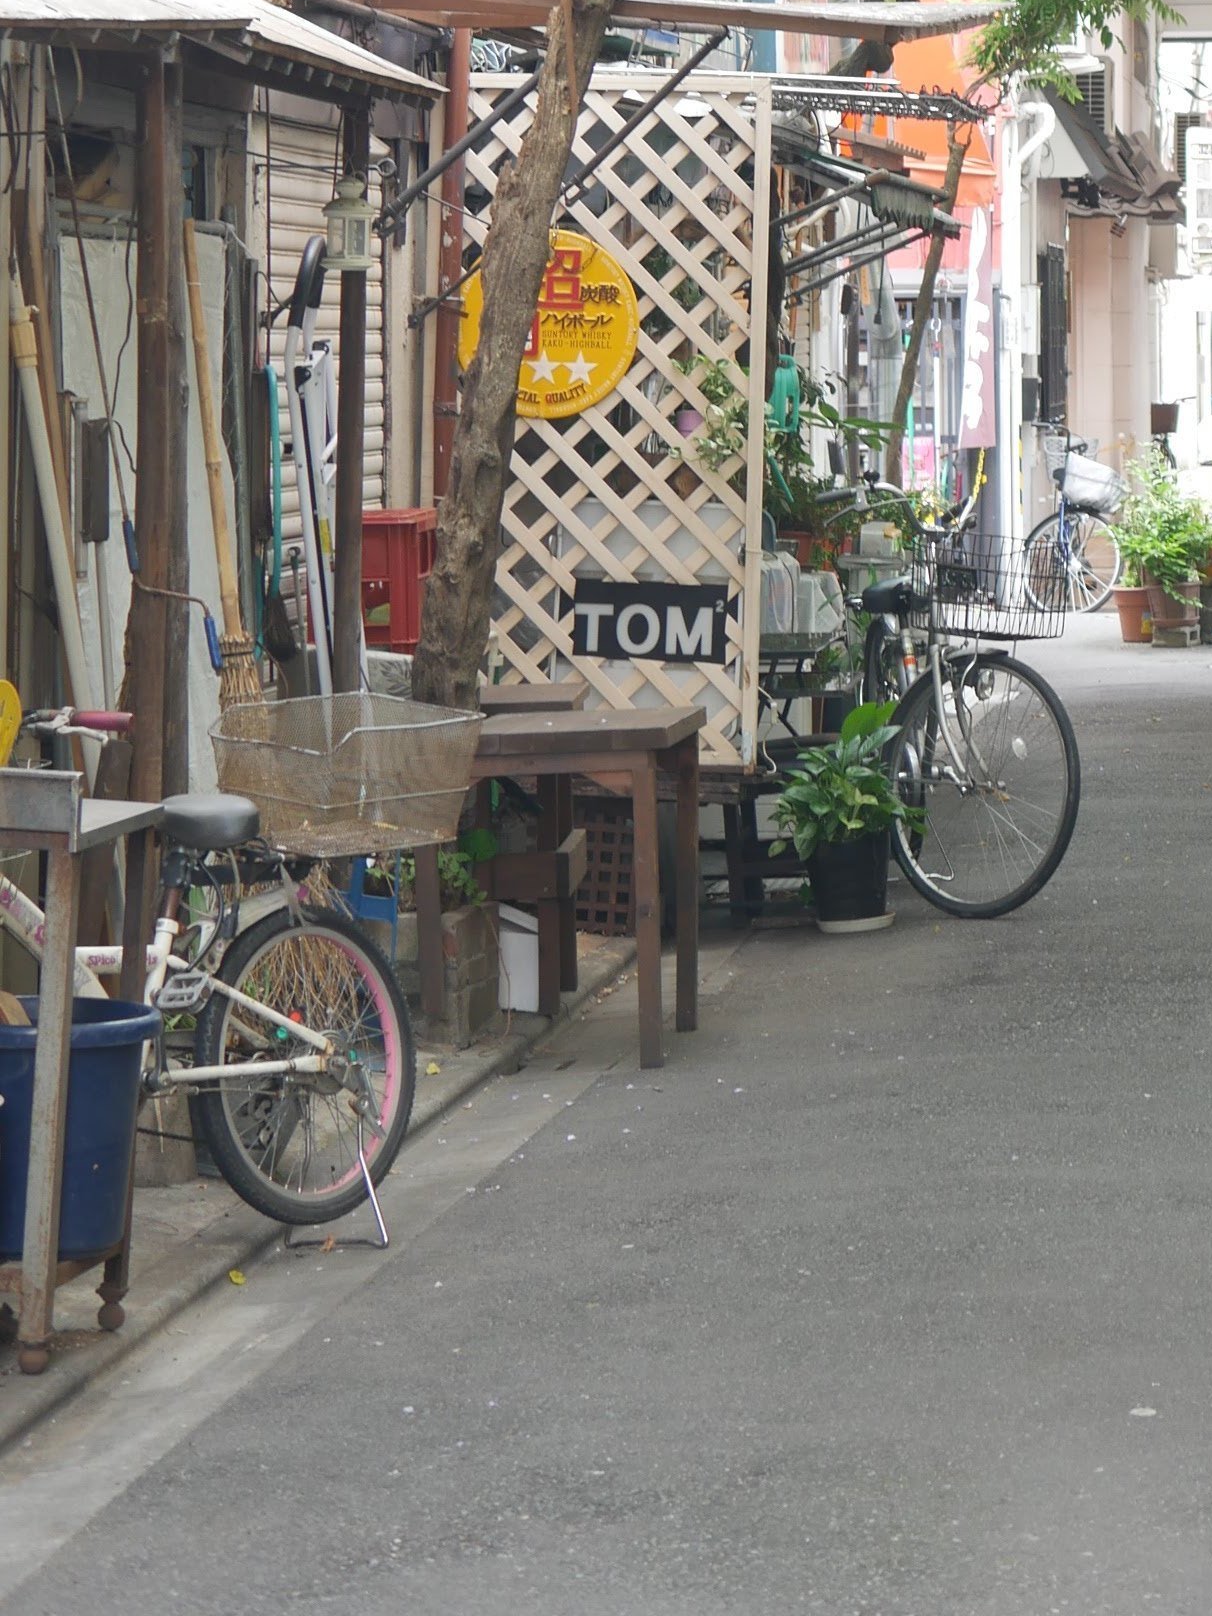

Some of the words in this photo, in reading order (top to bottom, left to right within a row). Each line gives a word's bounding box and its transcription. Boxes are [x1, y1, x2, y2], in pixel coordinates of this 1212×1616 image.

[541, 313, 614, 330] ハイボール
[582, 331, 612, 340] WHISKY
[545, 384, 586, 404] QUALITY
